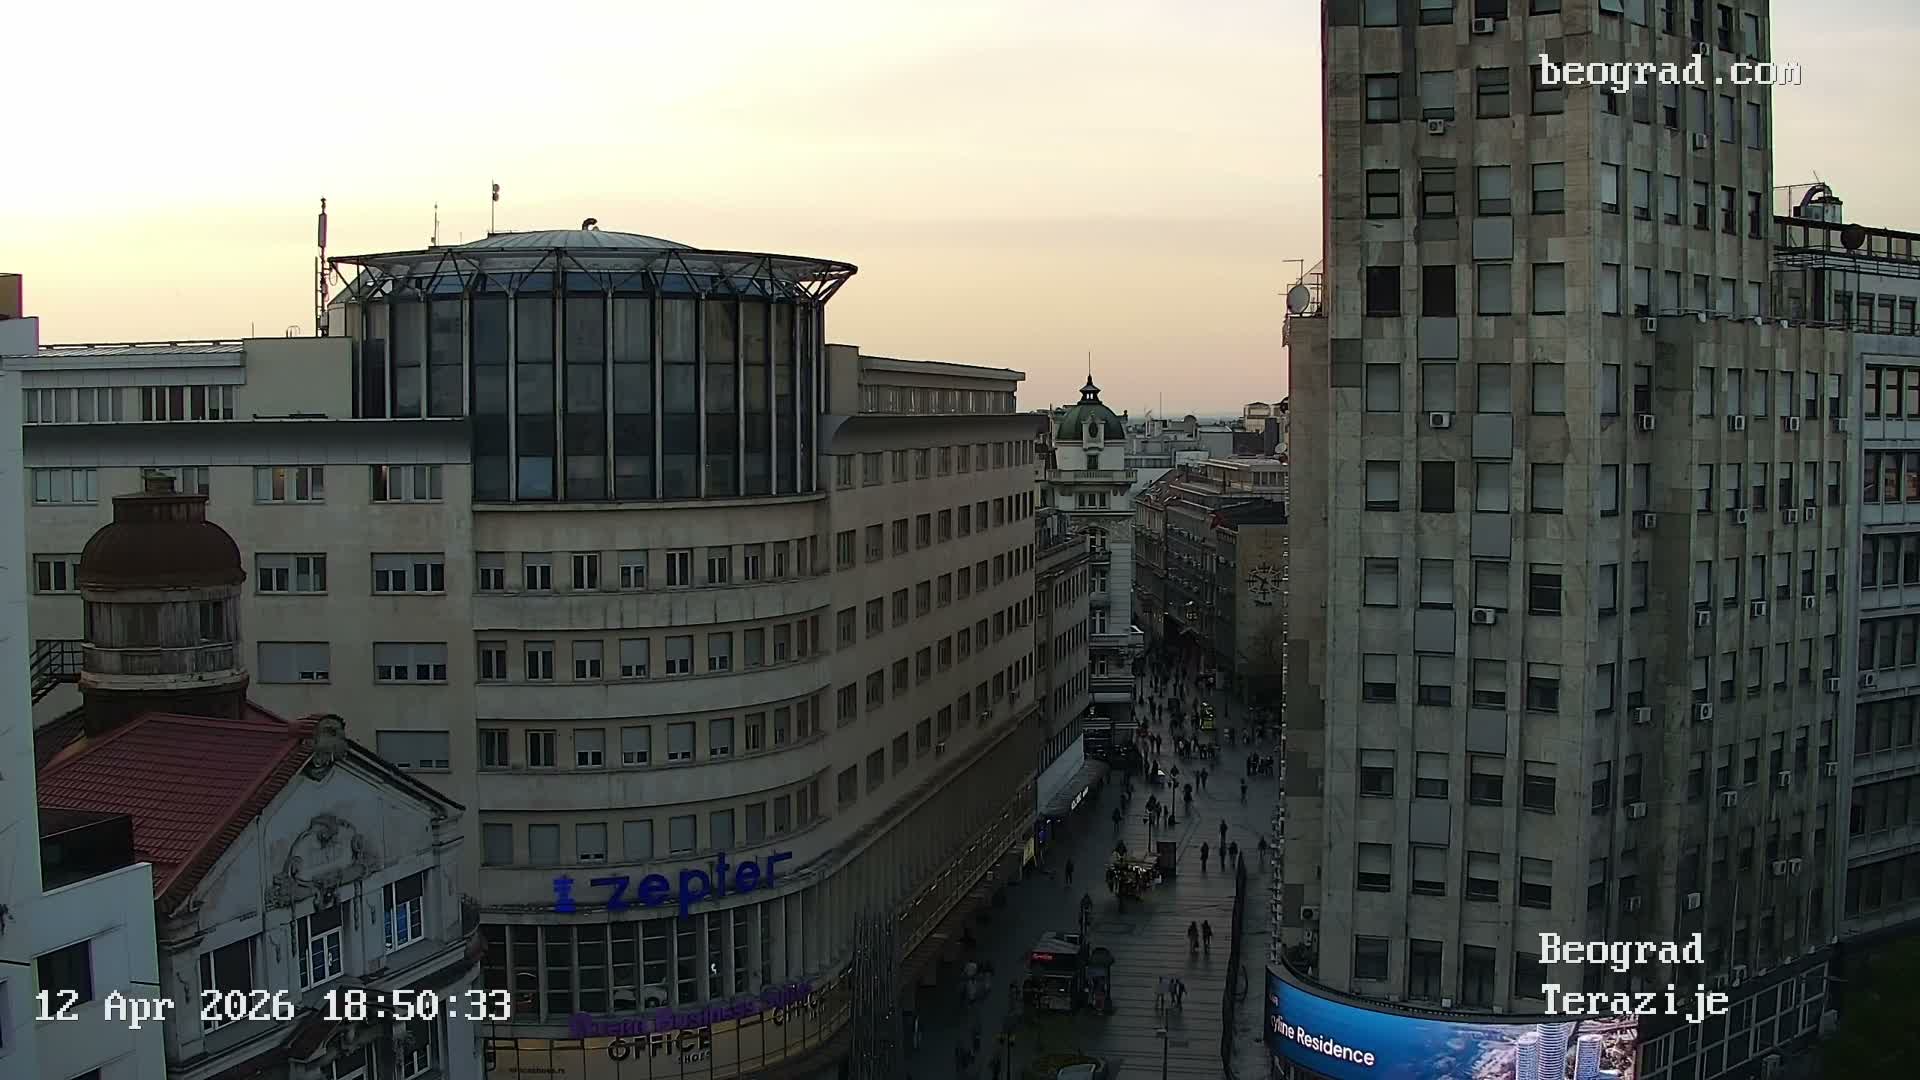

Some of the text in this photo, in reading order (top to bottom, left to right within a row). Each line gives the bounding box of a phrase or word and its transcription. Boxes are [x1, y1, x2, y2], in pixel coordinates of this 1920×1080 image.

[591, 852, 793, 923] zepter
[608, 1026, 711, 1061] OFFICE
[1296, 1026, 1376, 1067] Residence
